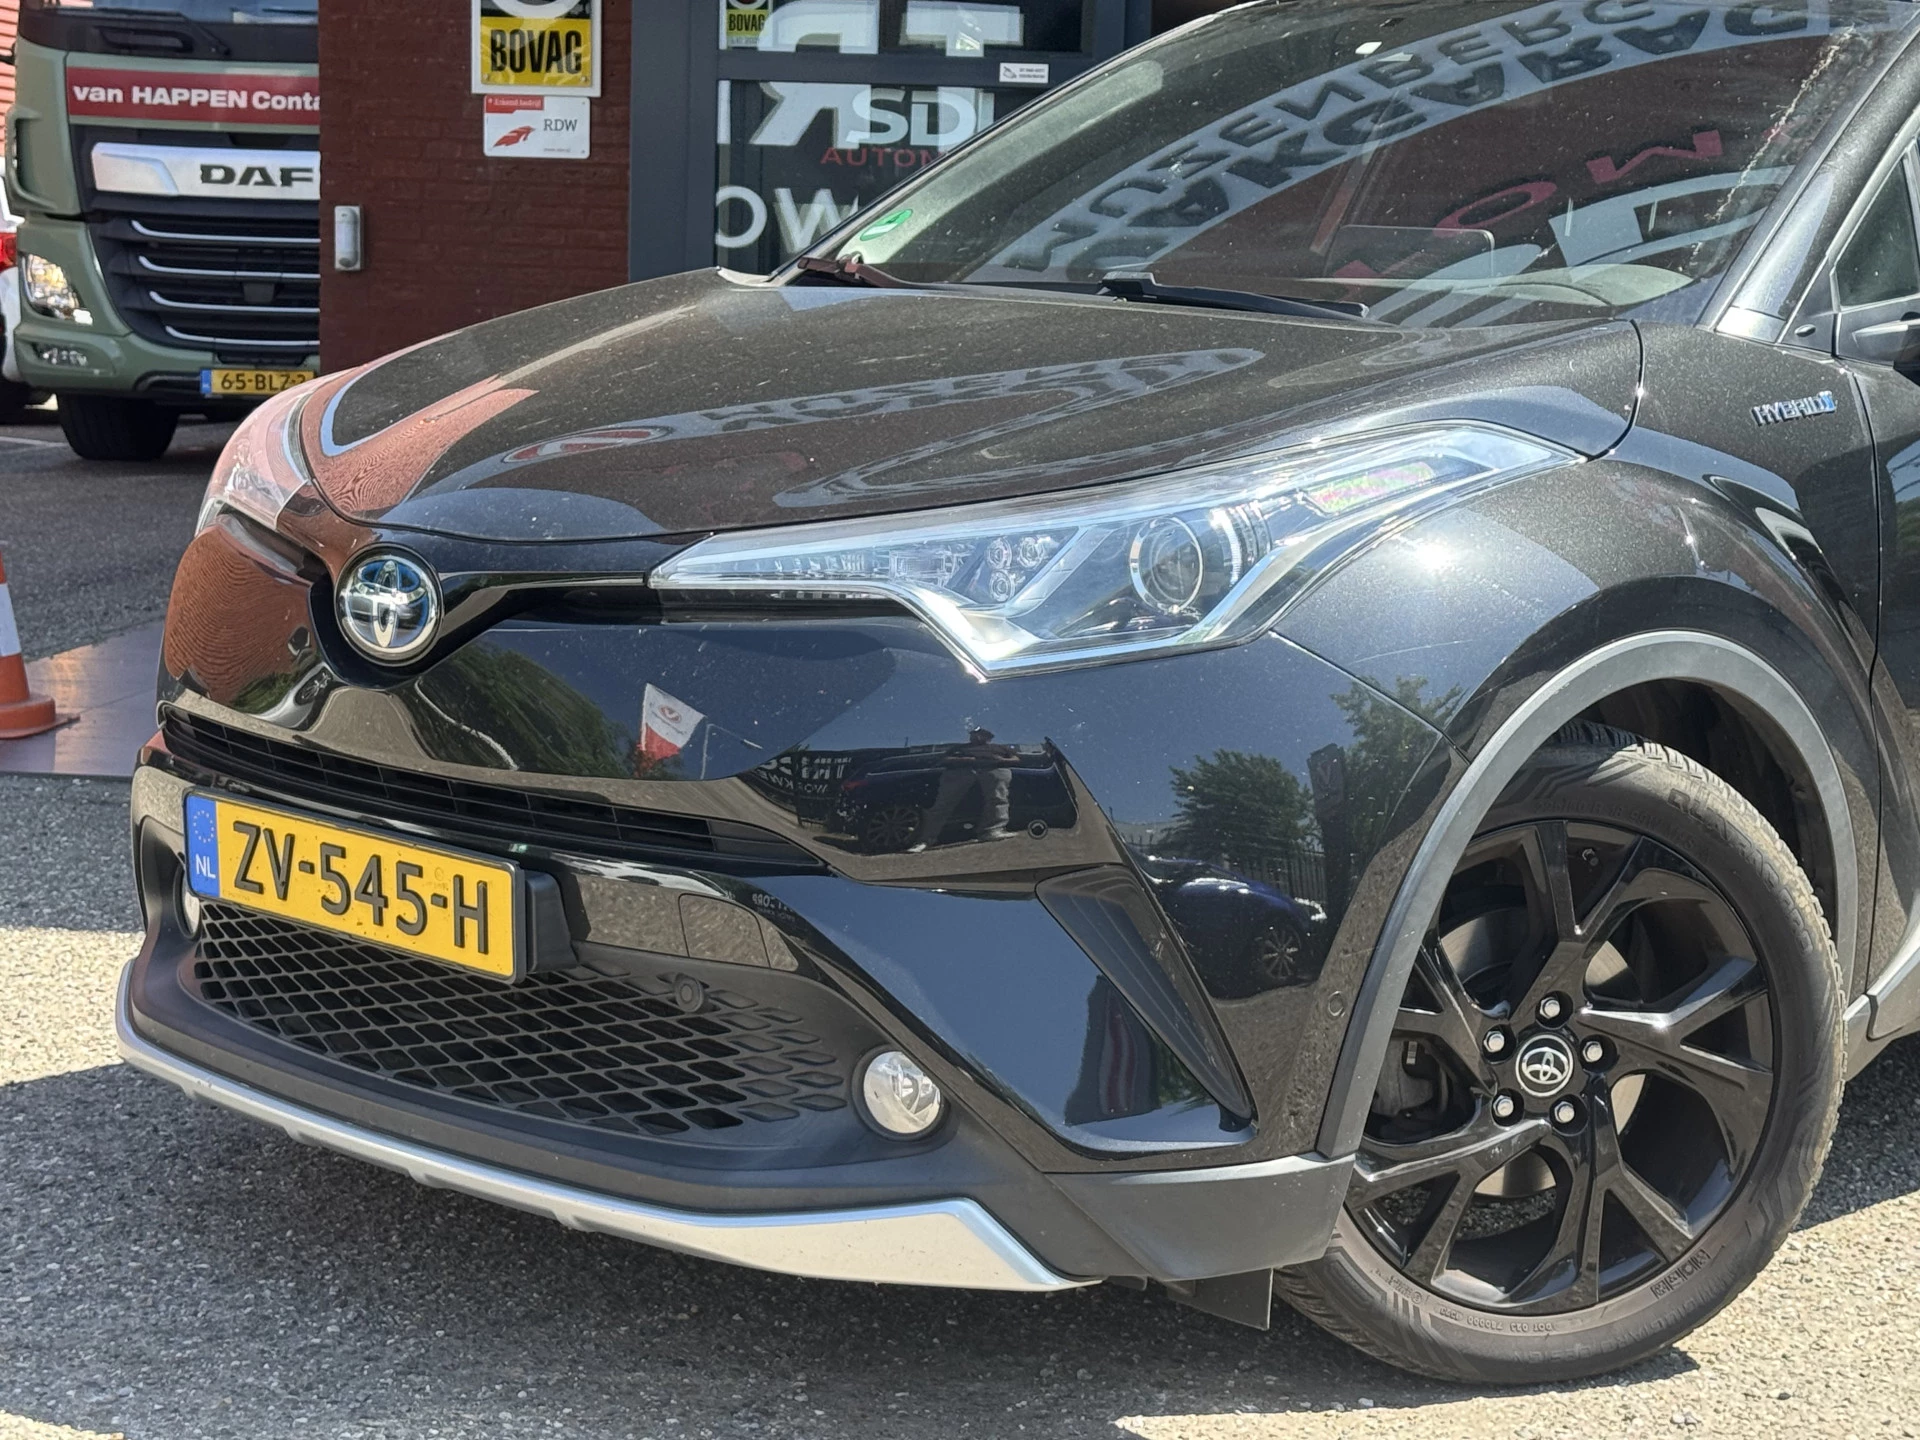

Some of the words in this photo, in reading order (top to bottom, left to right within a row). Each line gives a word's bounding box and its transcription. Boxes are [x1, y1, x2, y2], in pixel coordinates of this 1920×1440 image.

[490, 28, 582, 74] BOVAG
[73, 84, 124, 103] van
[132, 85, 249, 109] HAPPEN
[543, 118, 578, 132] RDW
[200, 164, 314, 188] DAF
[1752, 391, 1834, 427] HYBRID
[195, 853, 216, 879] NL
[232, 821, 489, 955] ZV-545-H
